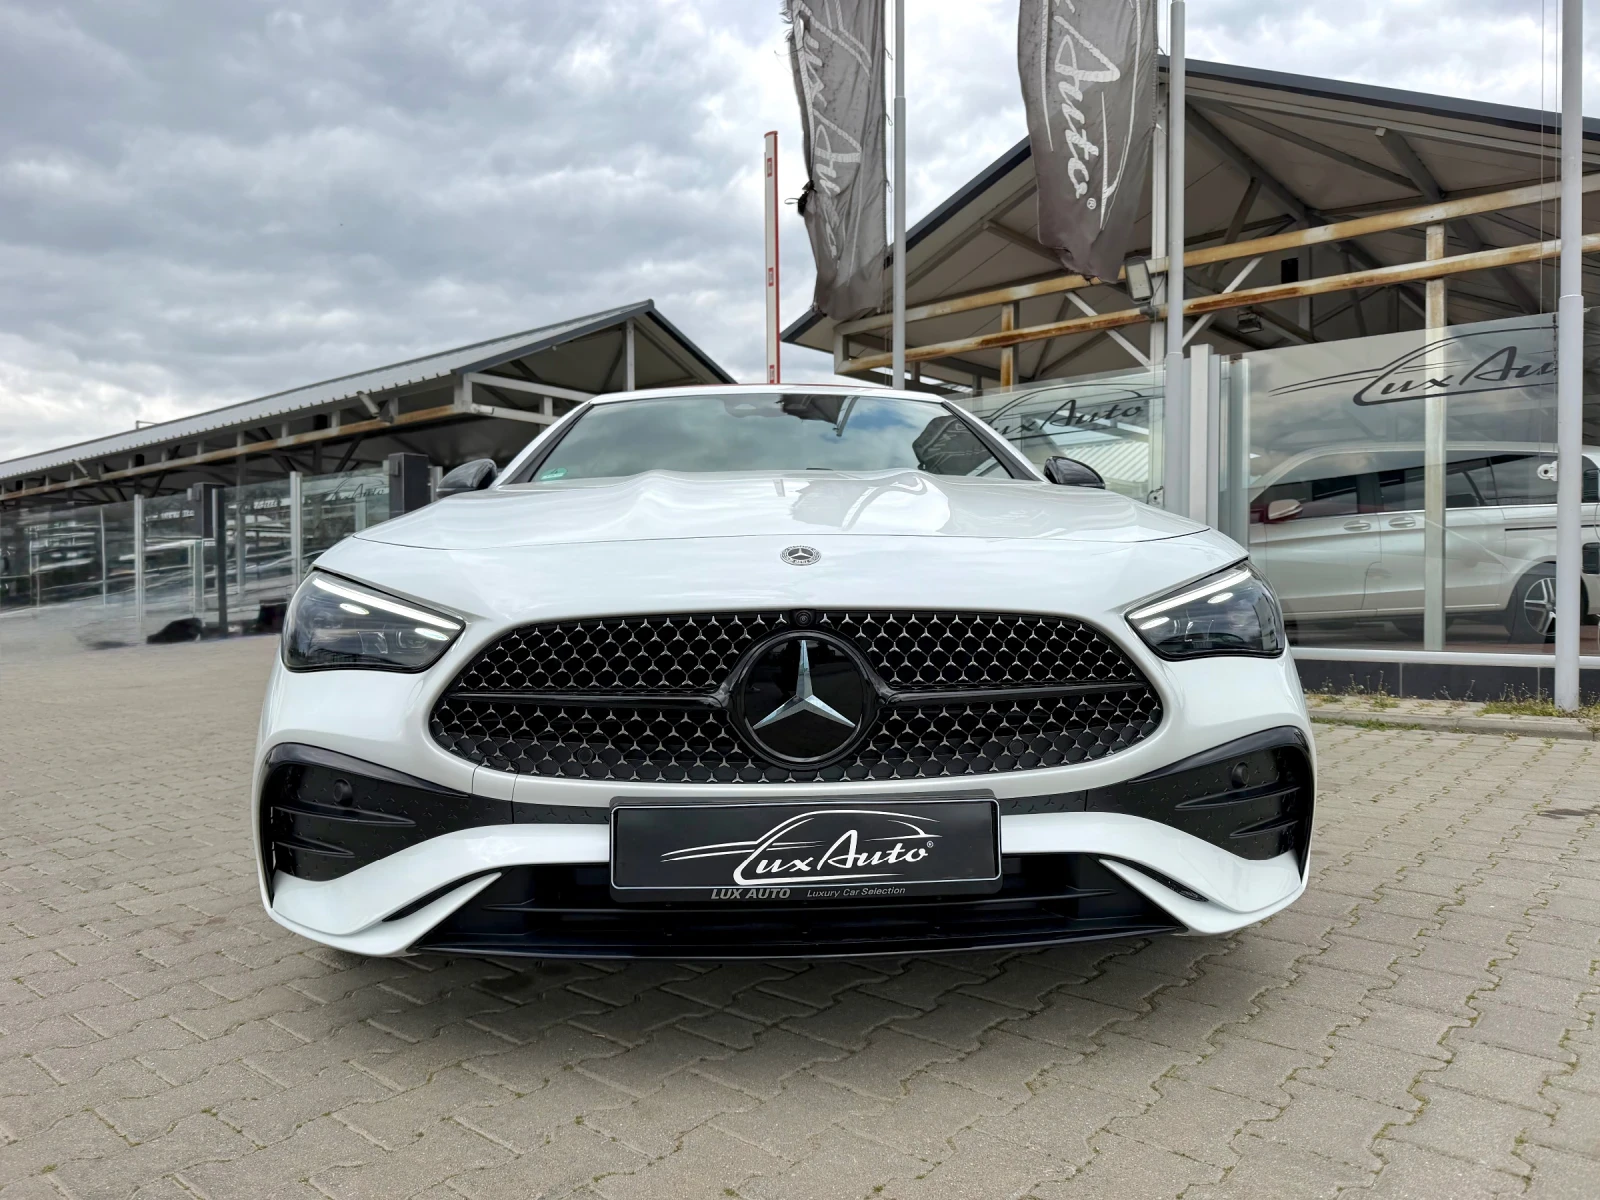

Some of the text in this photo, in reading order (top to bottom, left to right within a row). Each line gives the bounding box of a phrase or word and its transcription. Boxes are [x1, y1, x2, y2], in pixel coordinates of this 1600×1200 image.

[1353, 345, 1558, 406] Lux Au
[1039, 399, 1144, 430] Auto
[733, 838, 814, 886] Lux
[711, 888, 791, 899] LUX AUTO
[807, 886, 906, 898] Luxury Car Selection
